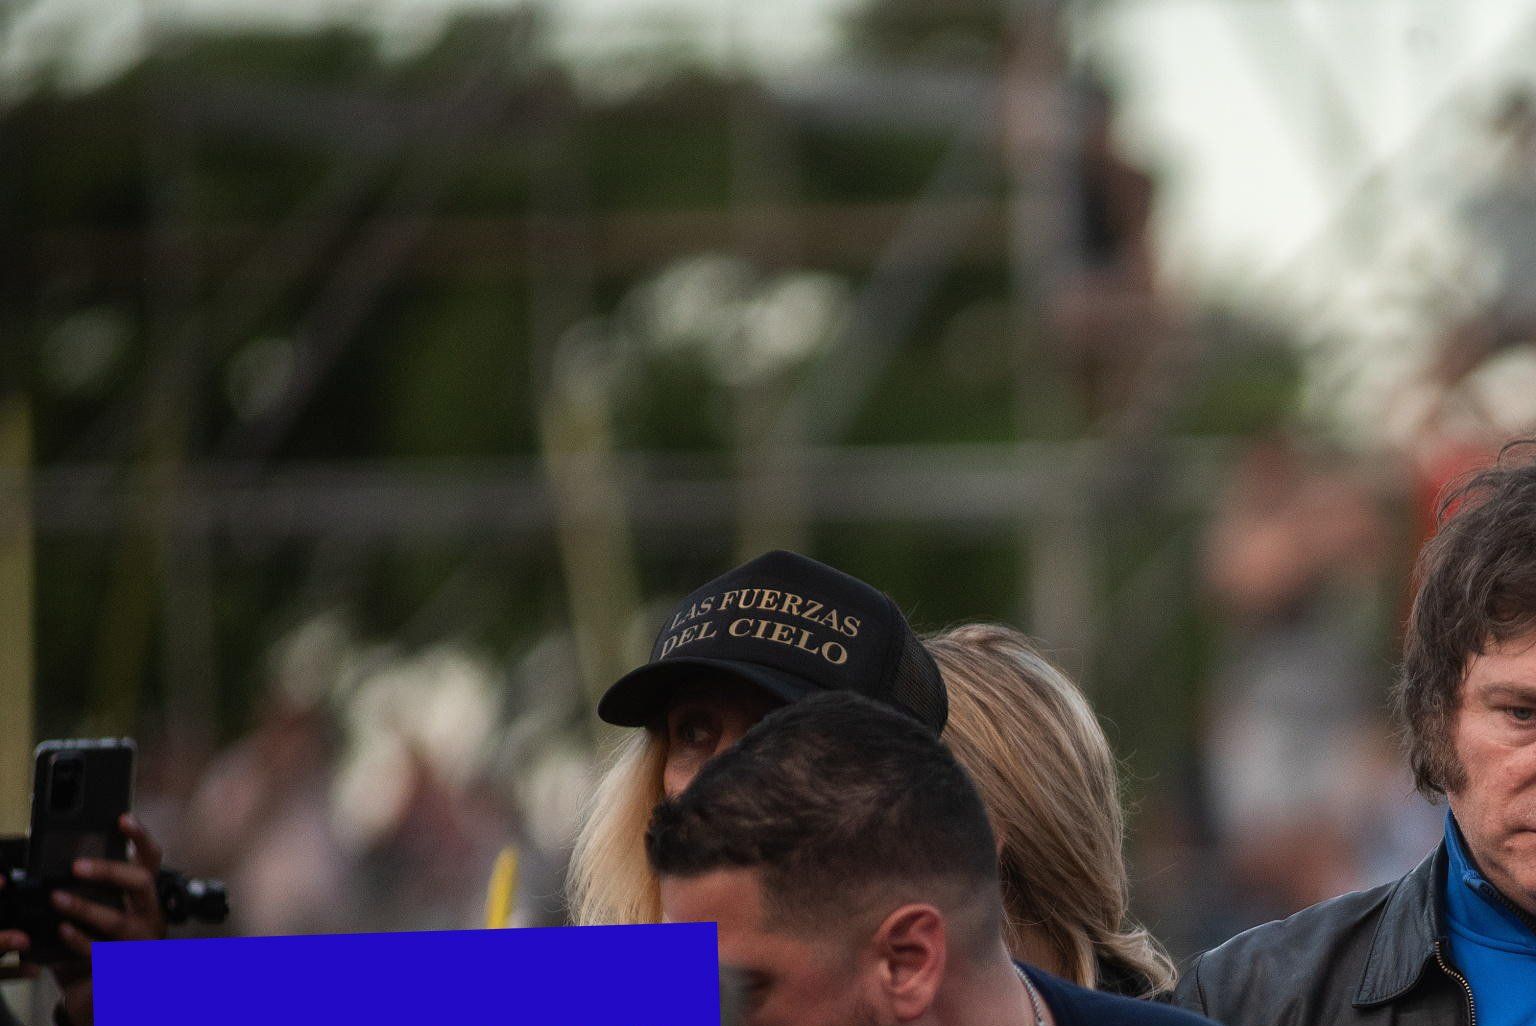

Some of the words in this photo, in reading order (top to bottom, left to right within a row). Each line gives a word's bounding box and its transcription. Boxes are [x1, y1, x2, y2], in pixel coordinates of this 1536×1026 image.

[670, 596, 716, 631] LAS
[718, 587, 863, 638] FUERZAS
[657, 619, 719, 661] DEL
[727, 617, 849, 666] CIELO
